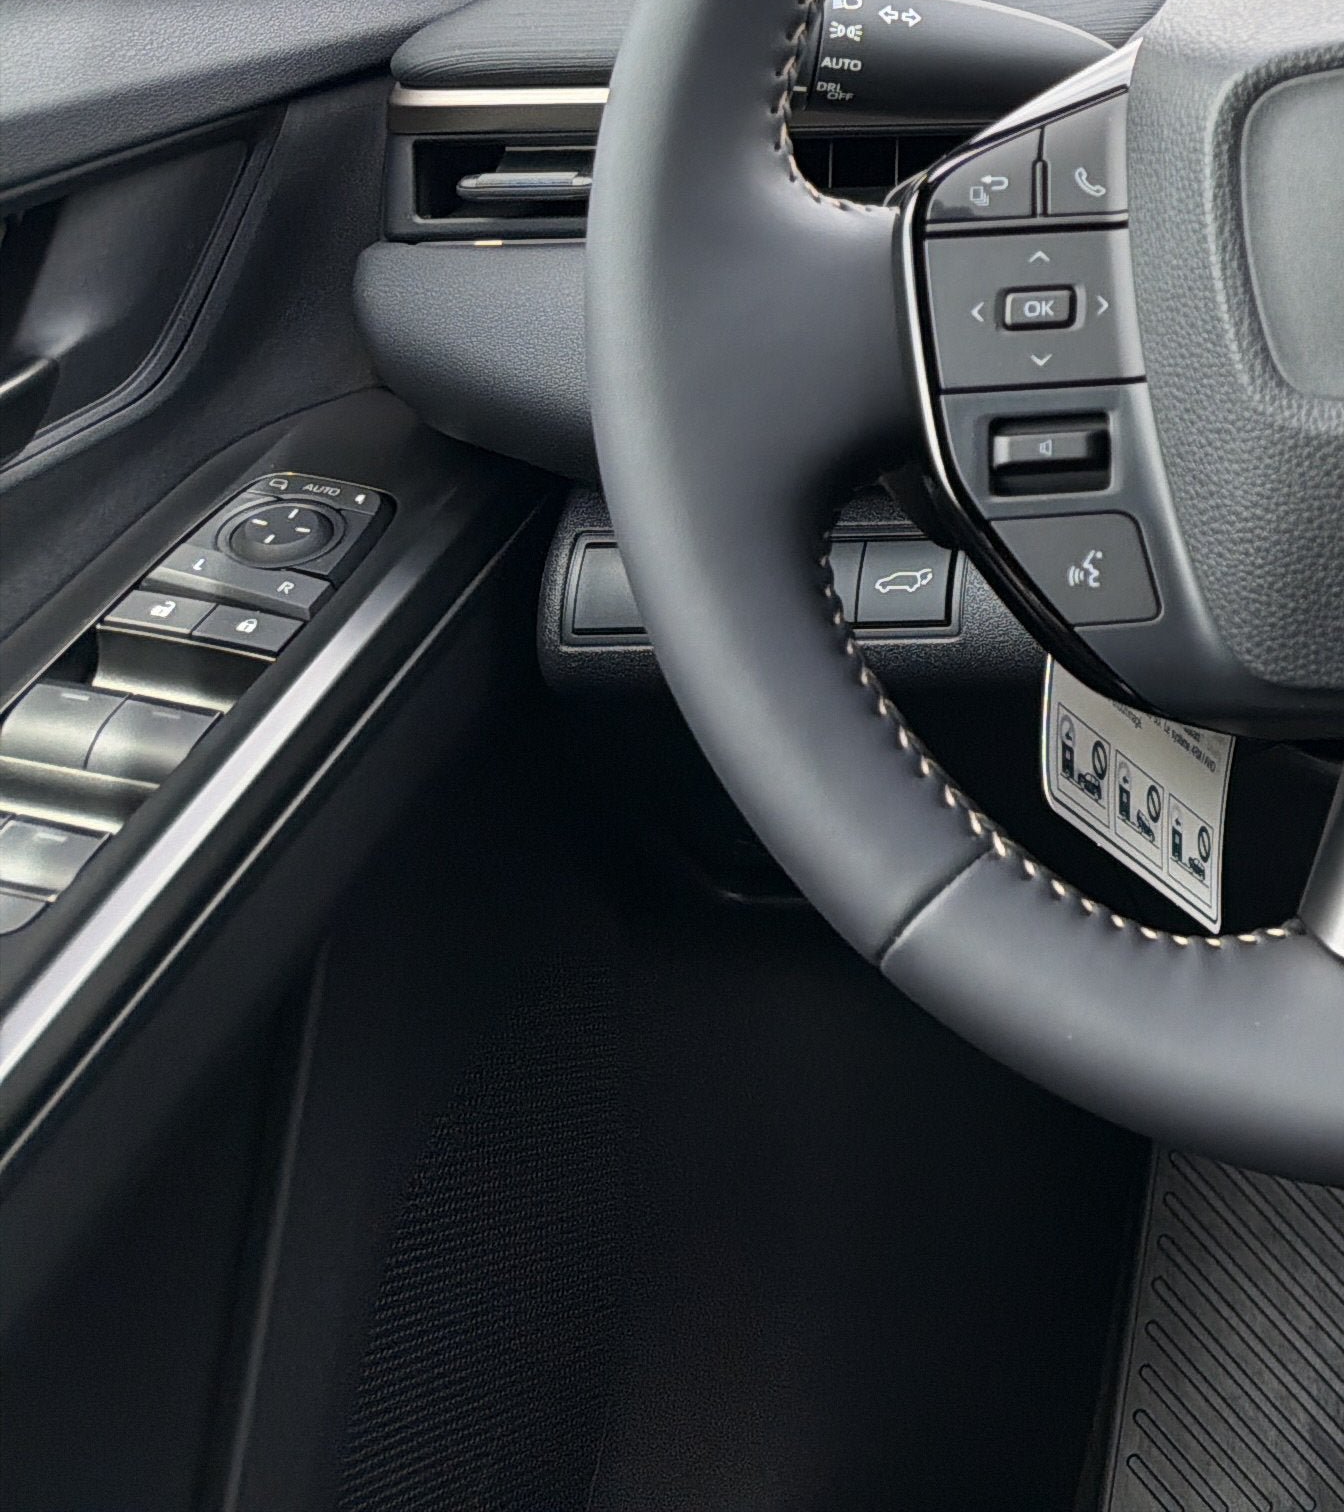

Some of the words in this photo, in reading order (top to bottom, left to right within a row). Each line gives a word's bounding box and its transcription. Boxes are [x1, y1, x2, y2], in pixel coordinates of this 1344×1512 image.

[820, 56, 862, 72] AUTO
[827, 91, 855, 101] OFF
[1024, 299, 1056, 318] OK
[302, 482, 341, 496] AUTO
[277, 580, 295, 595] R
